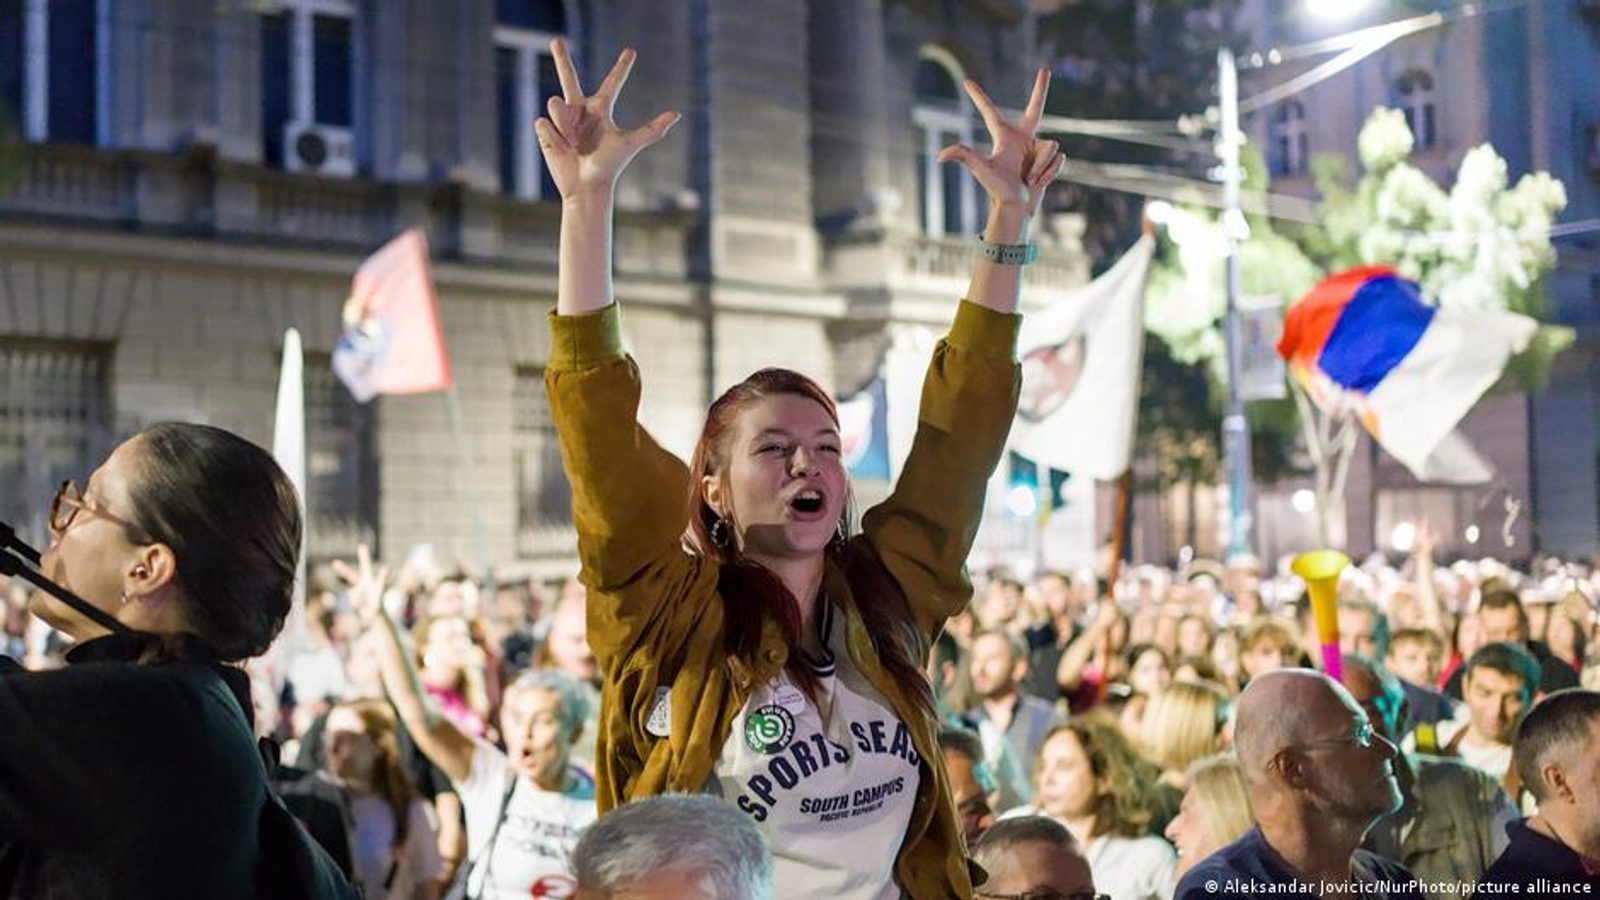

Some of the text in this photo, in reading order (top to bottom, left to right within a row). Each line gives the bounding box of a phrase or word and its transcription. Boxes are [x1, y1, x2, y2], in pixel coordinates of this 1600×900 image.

[737, 733, 850, 822] SPORTS
[800, 776, 905, 813] SOUTH CAMPUS
[820, 809, 850, 822] PACIFIC
